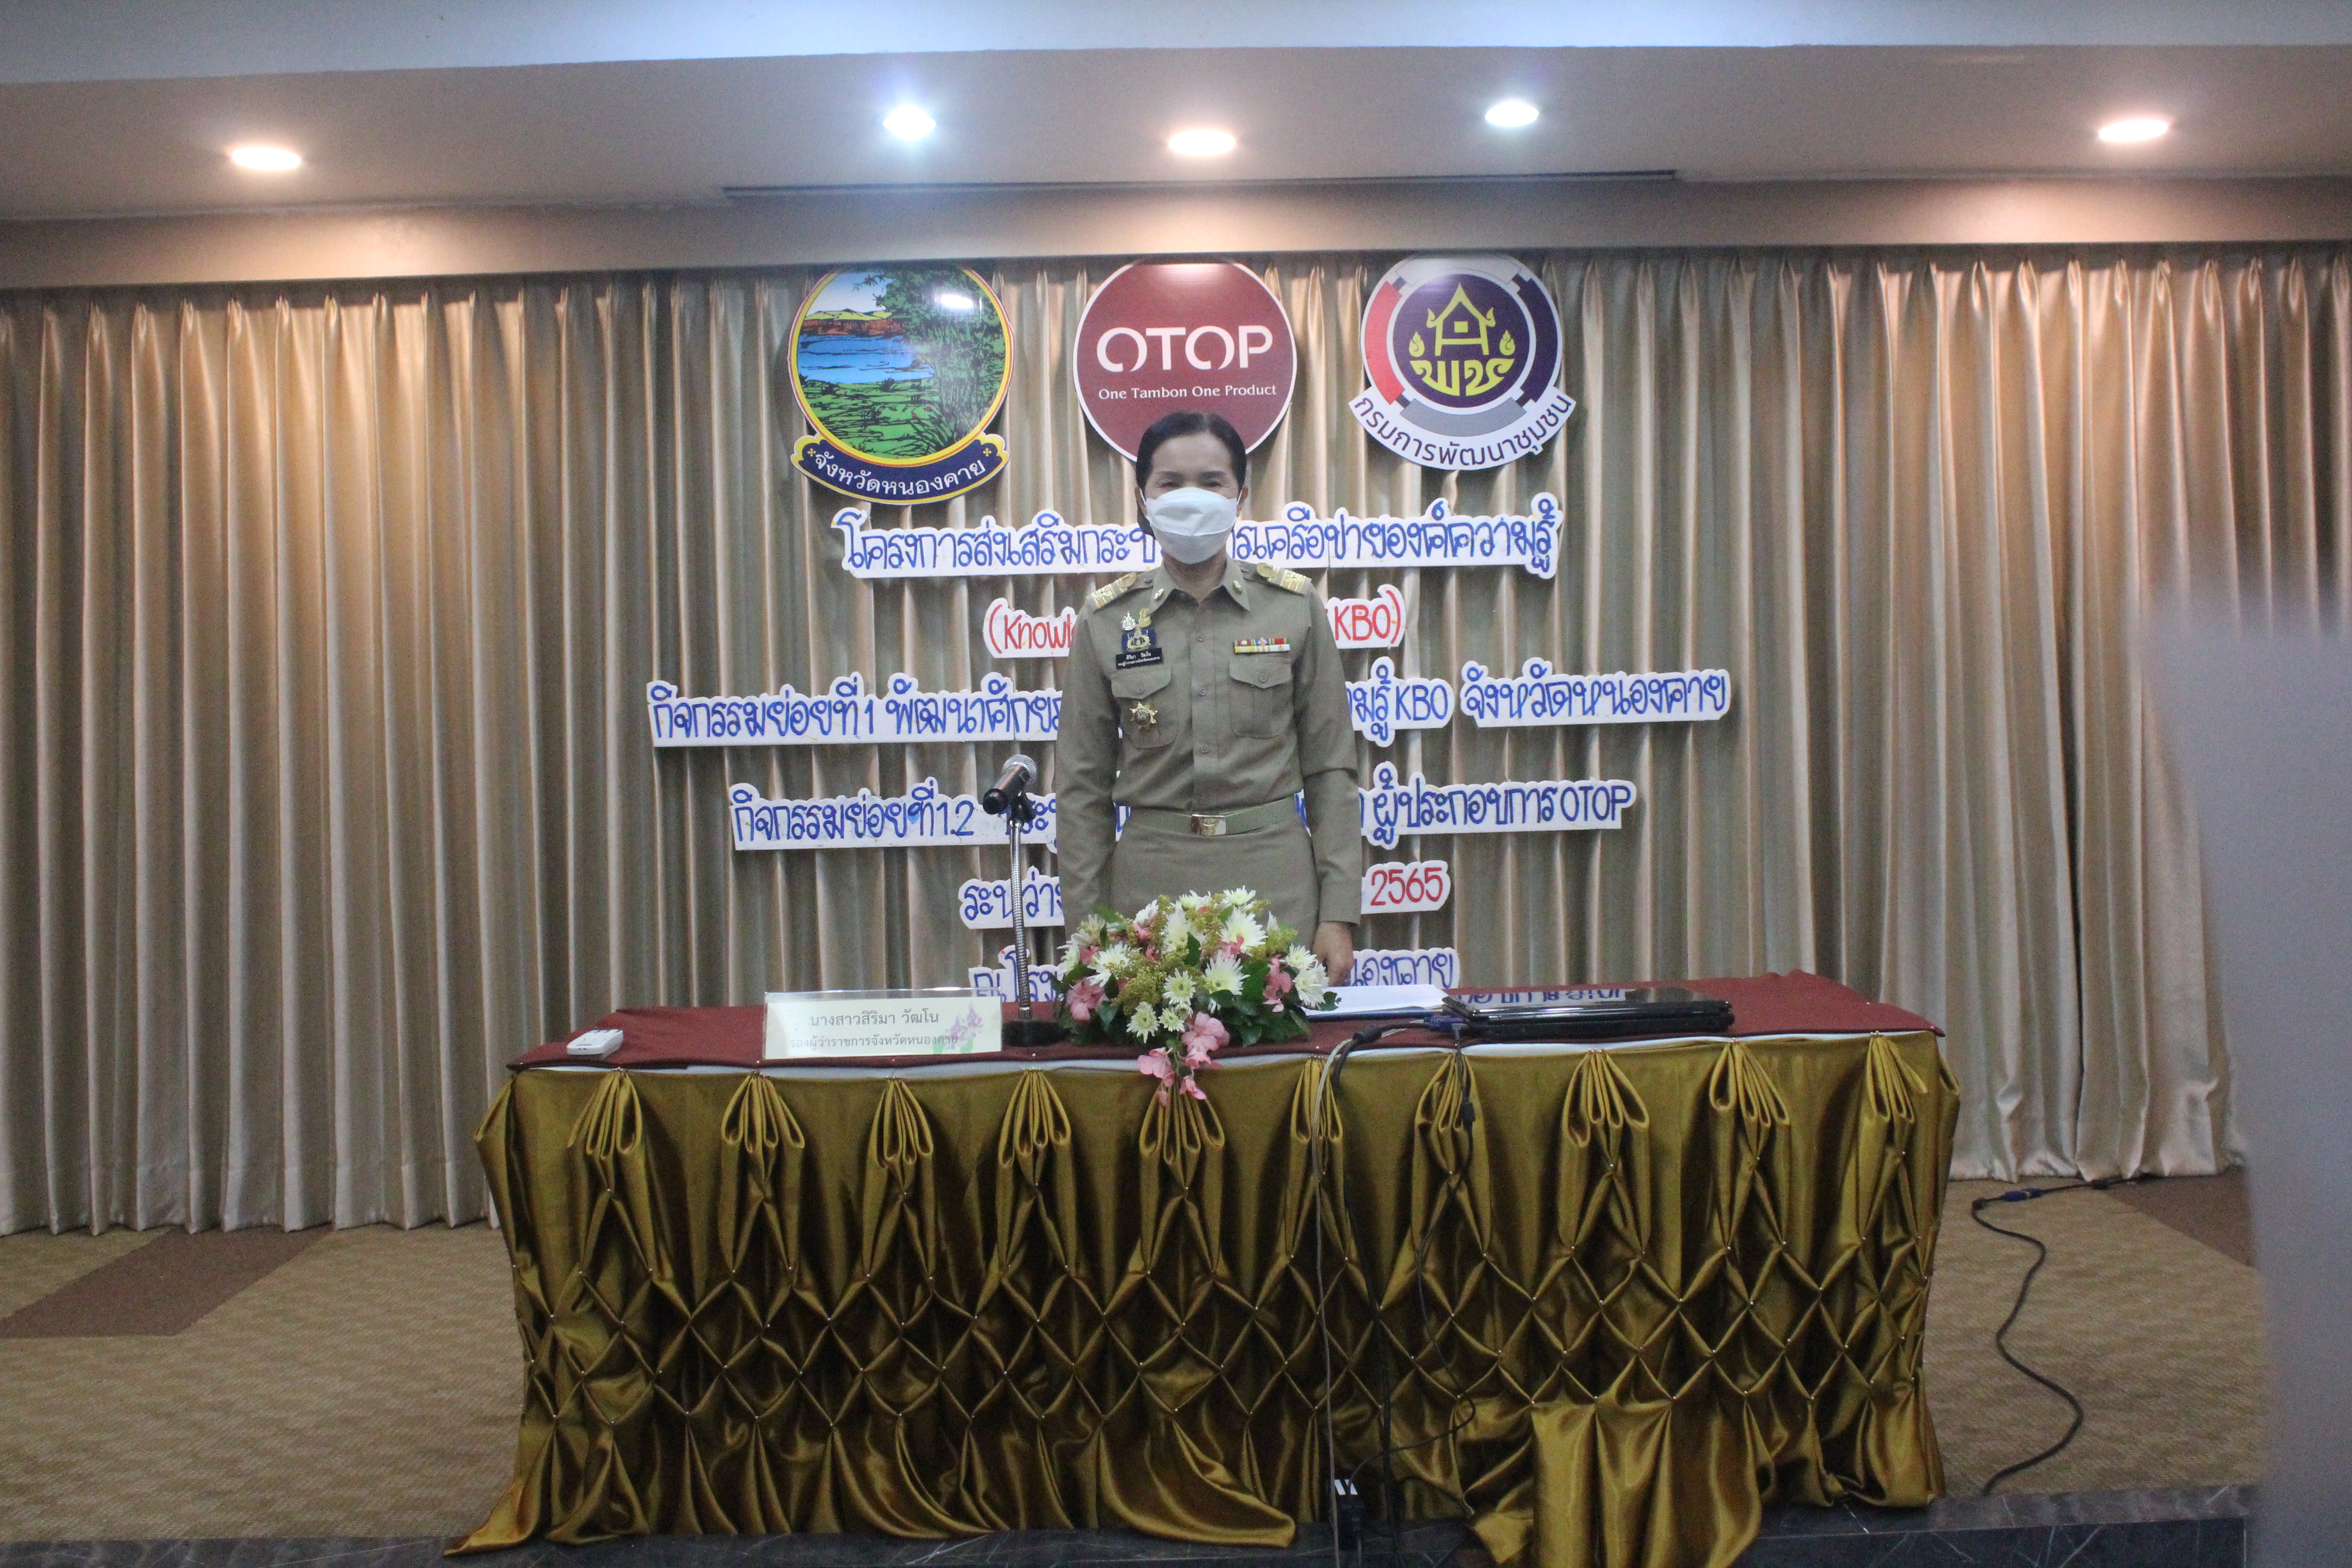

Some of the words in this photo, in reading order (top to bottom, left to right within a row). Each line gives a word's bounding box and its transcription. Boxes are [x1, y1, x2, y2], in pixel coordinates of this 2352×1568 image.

[1097, 325, 1273, 372] OTOP
[1098, 388, 1127, 400] One
[1131, 386, 1187, 399] Tambon
[1192, 385, 1220, 397] One
[1225, 384, 1277, 396] Product
[1354, 394, 1572, 466] กรมการพัฒนาชุมชน
[815, 451, 985, 495] จังหวัดหนองคาย
[836, 511, 1164, 570] โครงการส่งเสริมกระบ
[989, 604, 1073, 654] (Knowl
[1334, 590, 1401, 644] KBO)
[1465, 663, 1726, 719] จังหวัดหนองคาย
[1561, 785, 1632, 822] OTOP
[1371, 867, 1443, 906] 2565
[809, 1010, 896, 1026] นางสาวสิริมา
[901, 1008, 939, 1024] วัฒโน
[789, 1033, 958, 1051] รองผู้ว่าราชการจังหวัดหนองคาย
